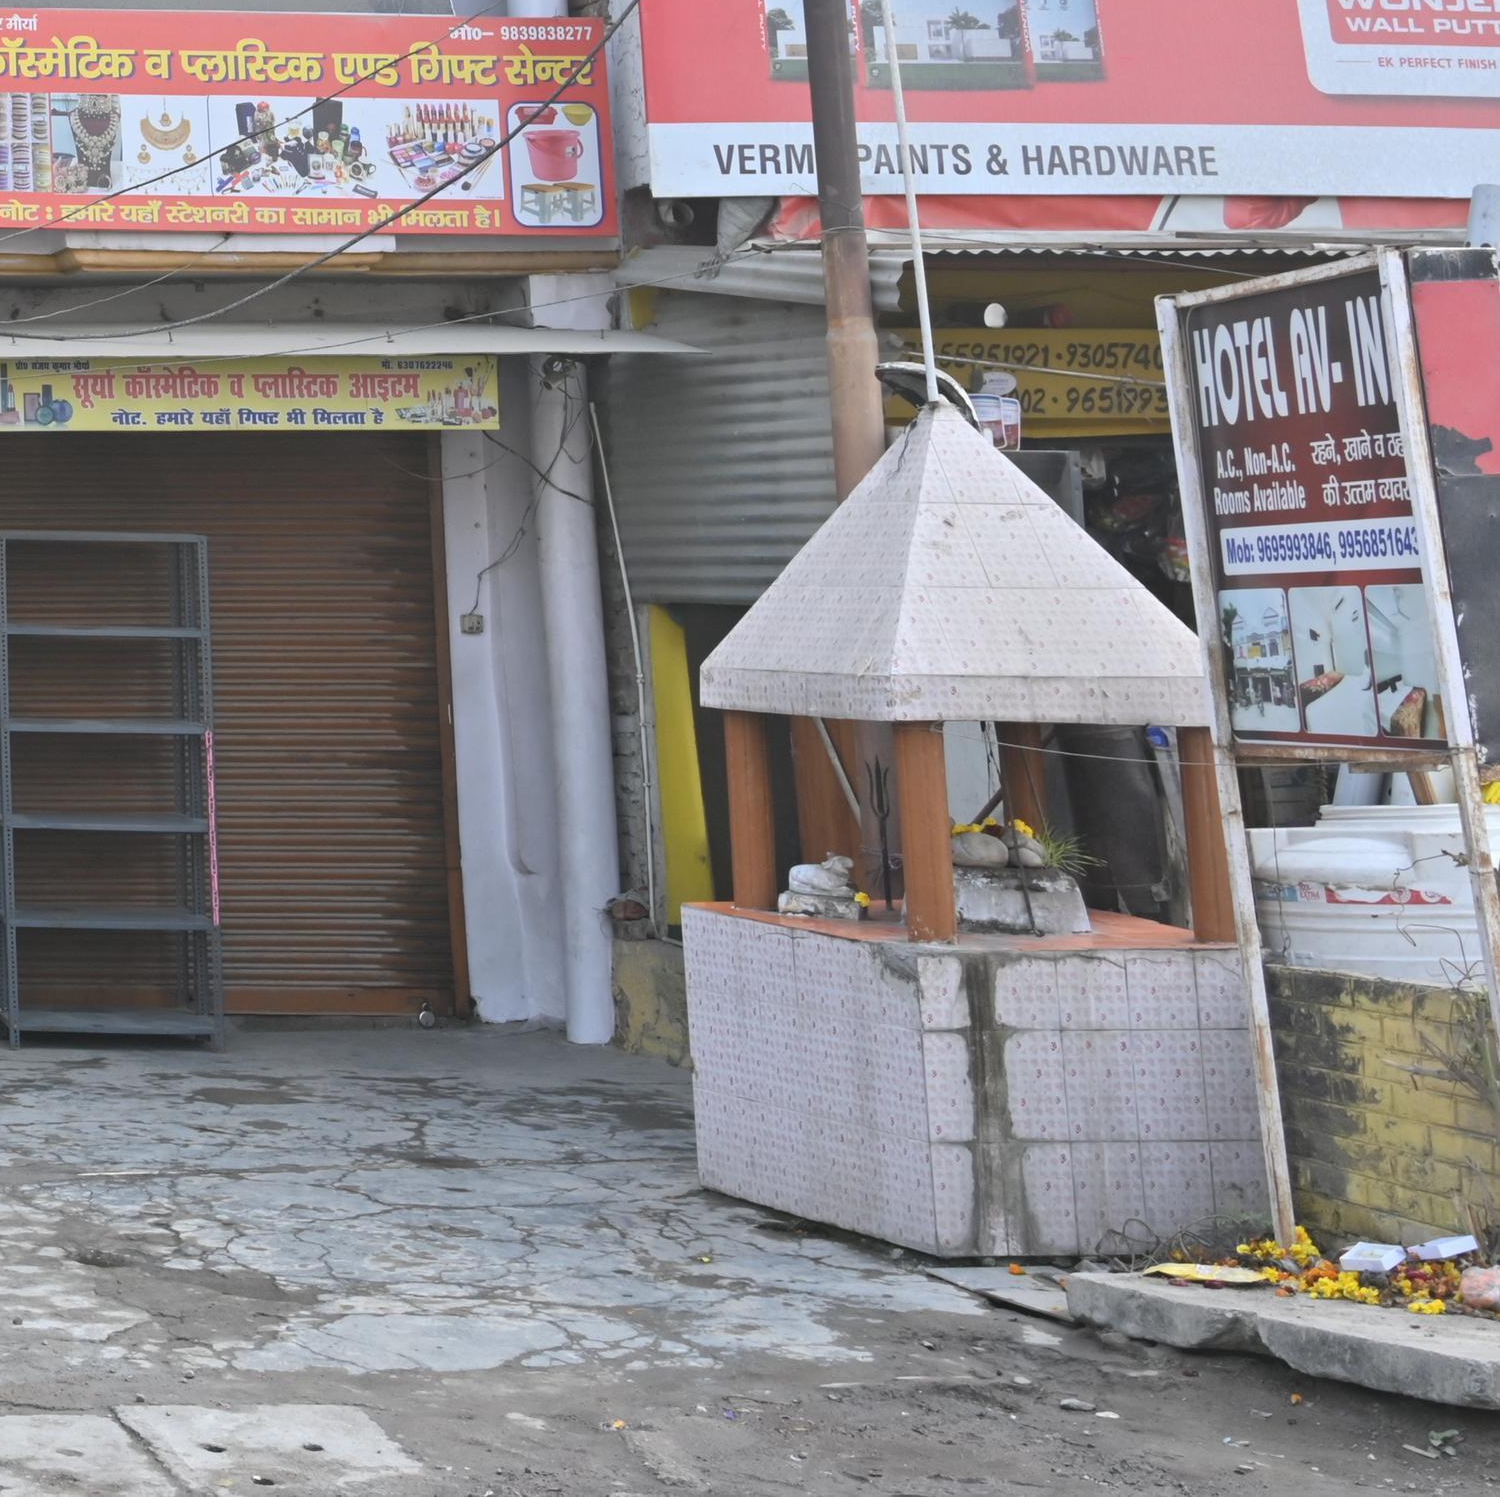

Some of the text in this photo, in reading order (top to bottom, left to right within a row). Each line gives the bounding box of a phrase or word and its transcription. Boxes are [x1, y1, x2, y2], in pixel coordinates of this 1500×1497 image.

[501, 26, 592, 41] 9839838277
[1344, 16, 1425, 34] WALL
[144, 50, 174, 79] व
[179, 38, 323, 82] प्लास्टिक
[332, 54, 400, 86] एण्ड
[409, 42, 497, 86] गिफ्ट
[504, 44, 595, 86] सेन्टर
[1399, 57, 1497, 70] PERFECT FINISH
[987, 144, 1219, 176] & HARDWARE
[292, 207, 362, 225] सामान
[1193, 305, 1343, 428] HOTEL AV-
[1244, 443, 1296, 476] Non-A.C.
[1214, 479, 1306, 515] Rooms Available
[1226, 532, 1336, 565] Mob: 9695993846,
